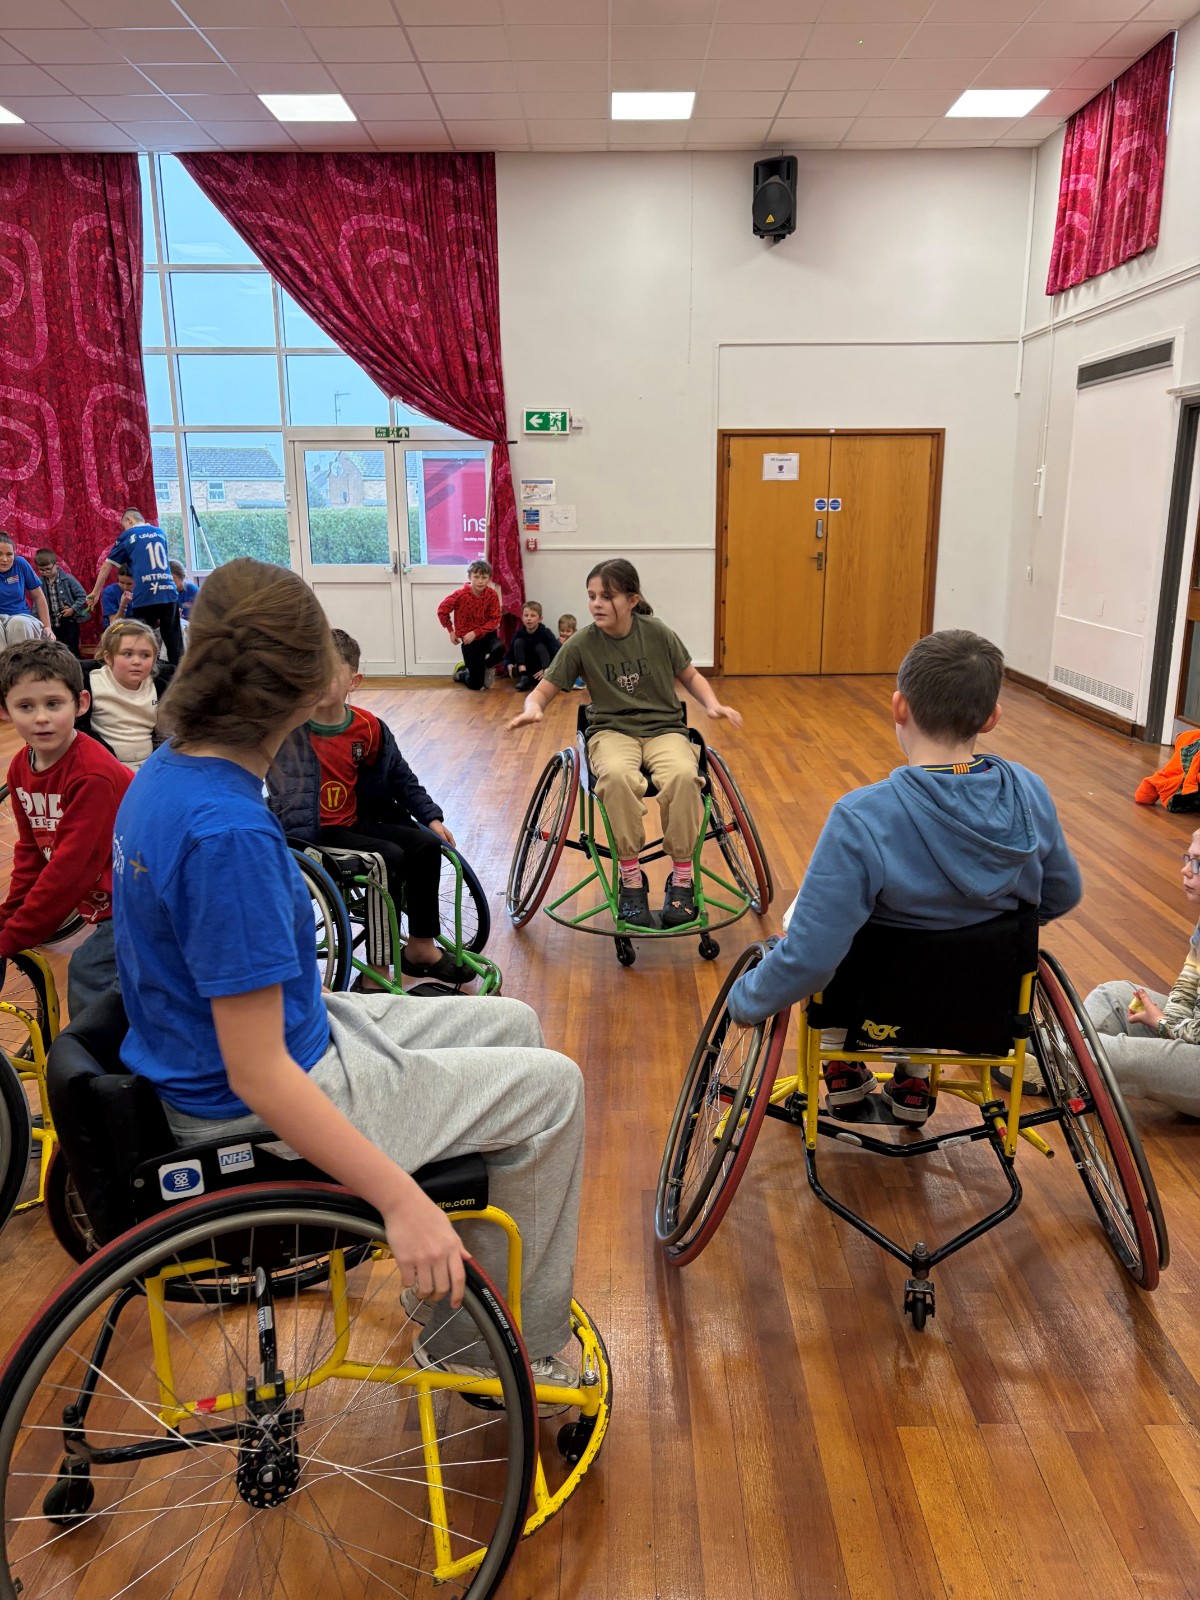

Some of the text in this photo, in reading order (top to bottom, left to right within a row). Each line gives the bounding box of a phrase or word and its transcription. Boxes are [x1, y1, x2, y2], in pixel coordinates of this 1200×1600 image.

[145, 541, 168, 571] 10
[603, 657, 652, 682] BEE
[326, 786, 341, 808] 17
[831, 1078, 848, 1089] NIKE
[904, 1094, 924, 1105] NIKE
[221, 1150, 251, 1166] NHS
[257, 1308, 266, 1333] NHS
